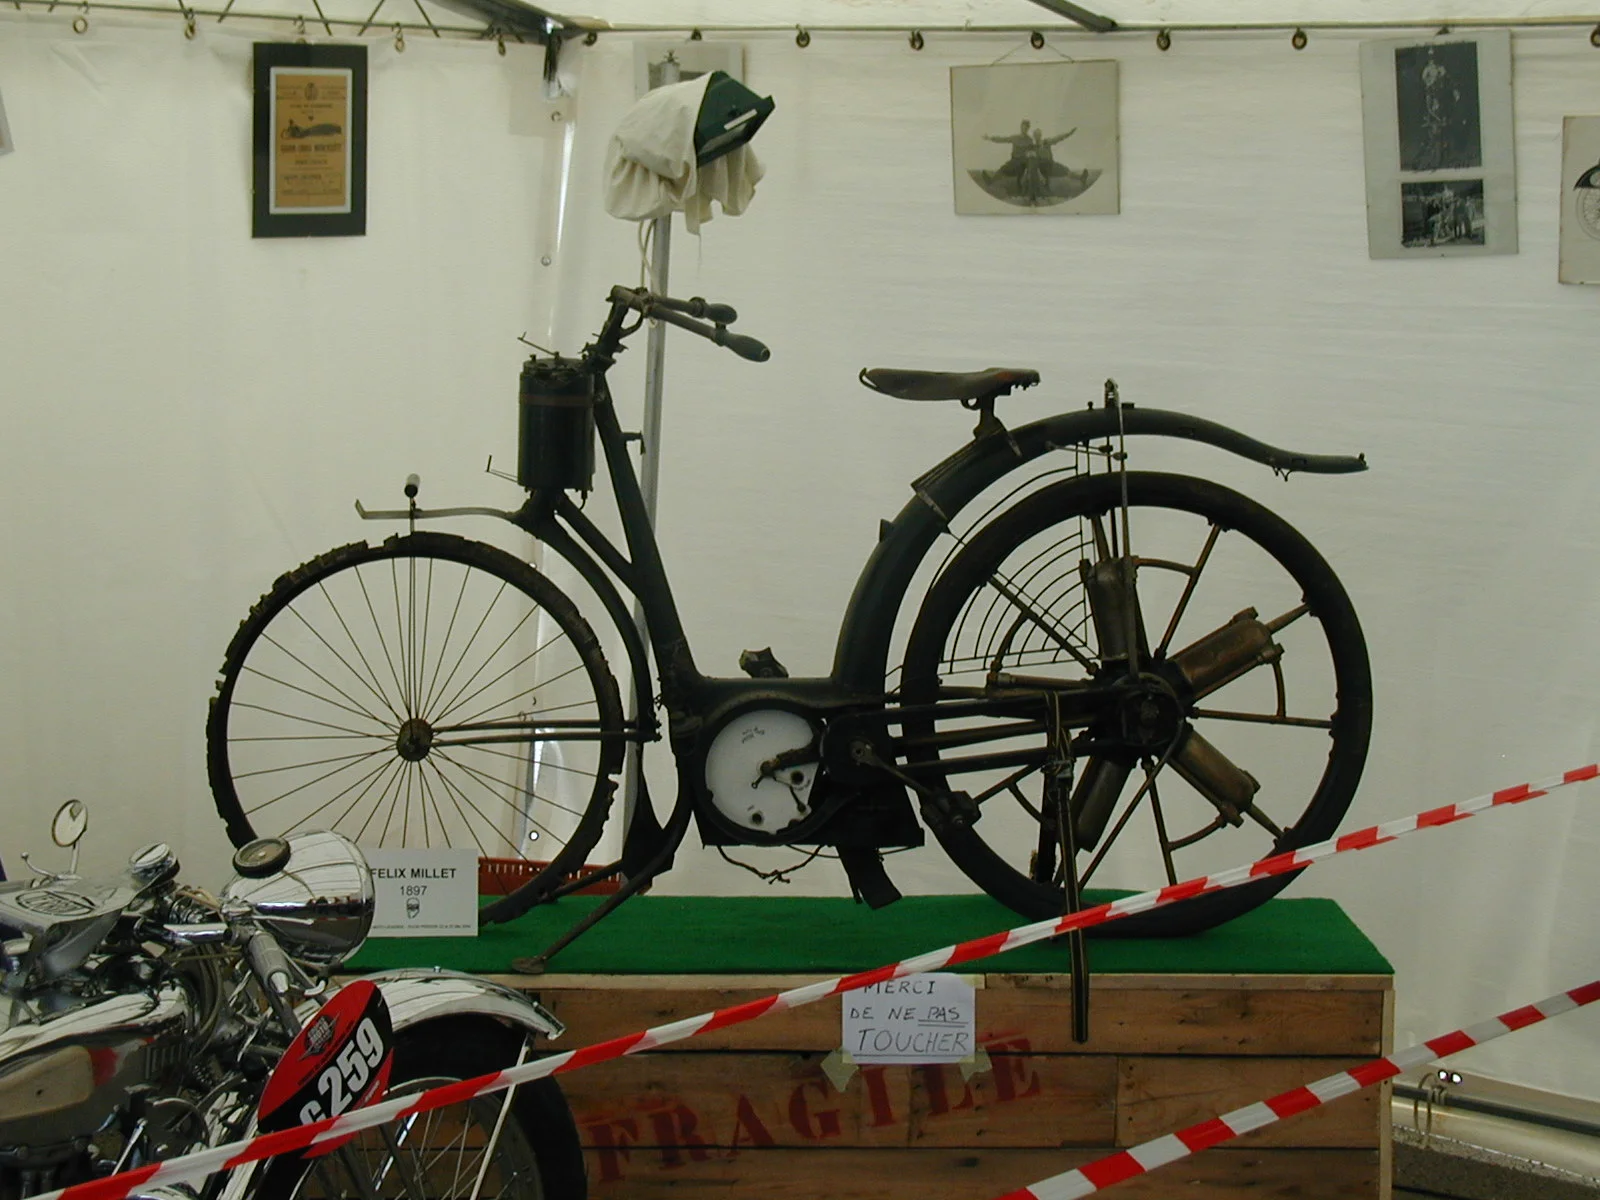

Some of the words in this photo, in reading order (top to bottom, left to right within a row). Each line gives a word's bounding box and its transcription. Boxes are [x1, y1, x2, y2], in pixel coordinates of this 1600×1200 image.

[371, 868, 407, 879] FELIX
[410, 868, 457, 879] MILLET
[400, 885, 428, 896] 1897
[863, 980, 936, 995] MERCI
[850, 1006, 875, 1020] DE
[887, 1006, 917, 1021] NE
[927, 1006, 960, 1022] PAS
[858, 1028, 970, 1054] TOUCHER
[589, 1037, 1041, 1183] FRAGILE
